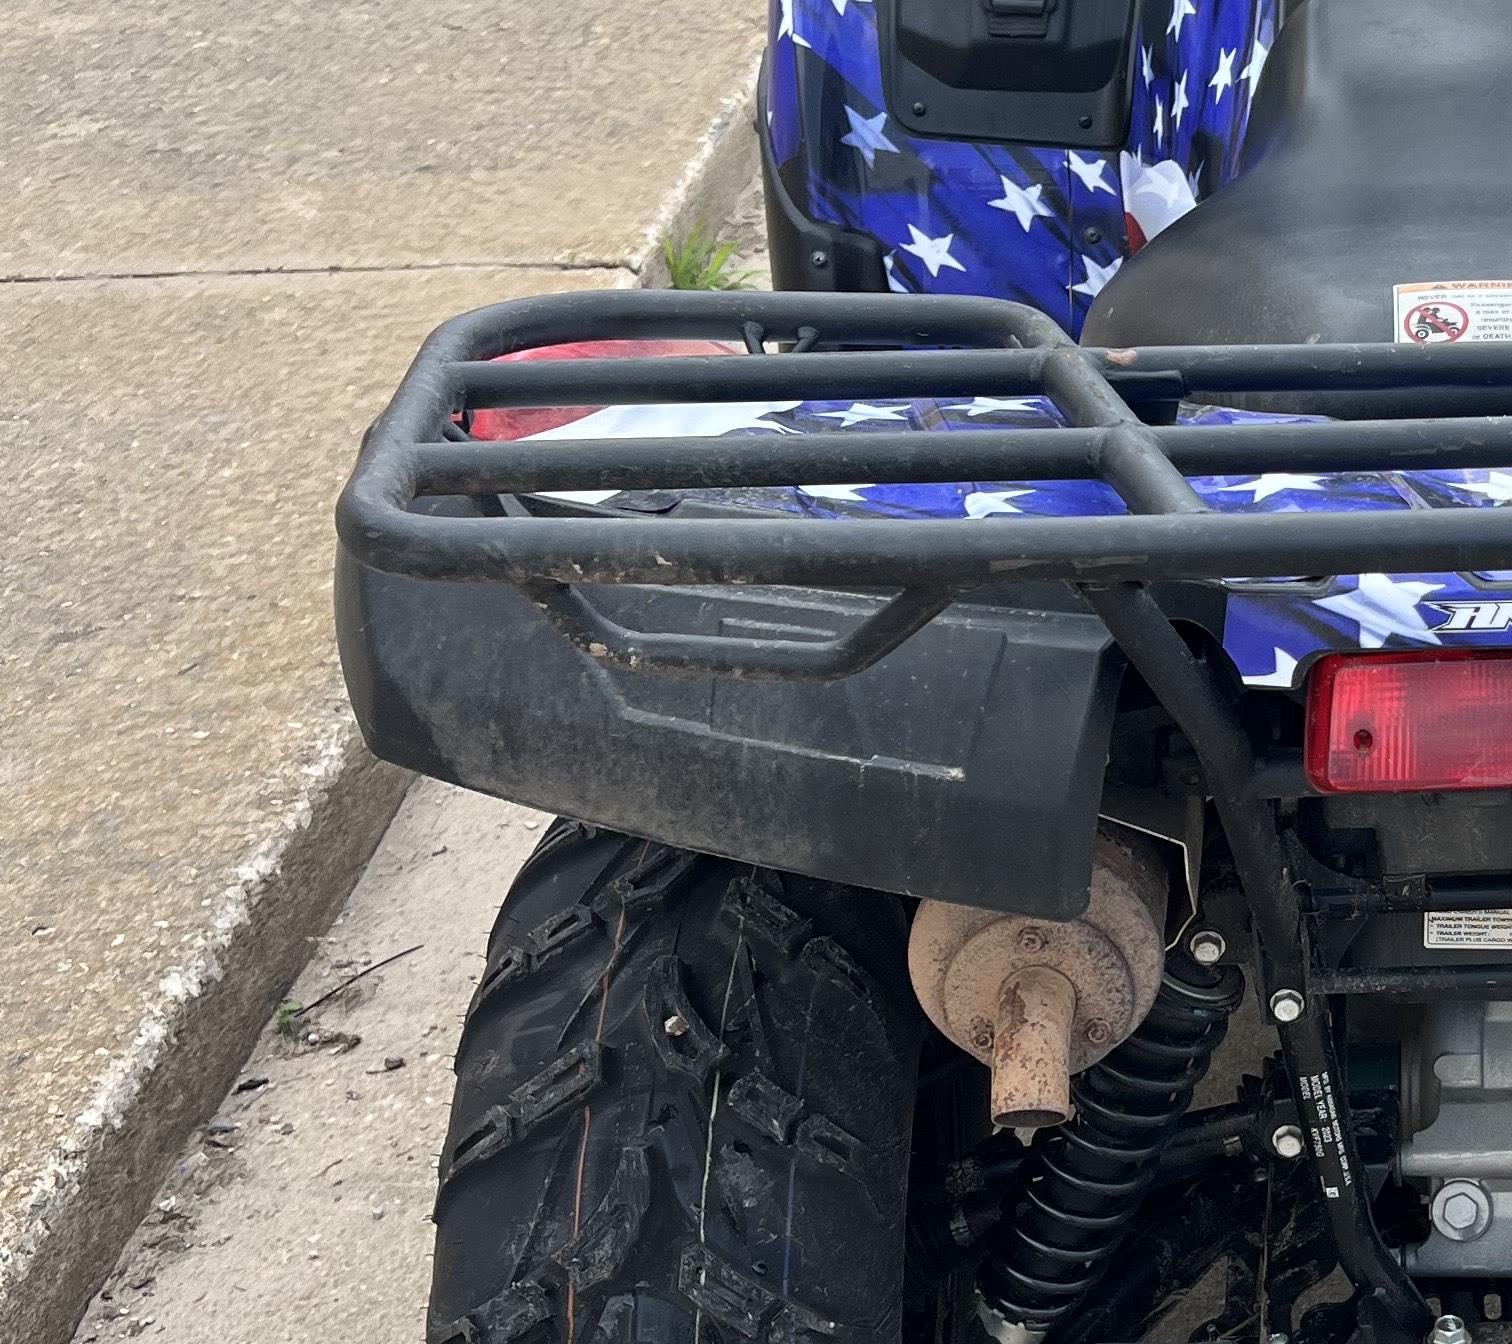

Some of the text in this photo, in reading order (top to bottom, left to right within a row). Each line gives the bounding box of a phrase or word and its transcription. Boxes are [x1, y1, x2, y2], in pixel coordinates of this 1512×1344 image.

[1299, 1076, 1311, 1100] MODEL
[1310, 1074, 1322, 1099] MODEL
[1321, 1126, 1332, 1143] 2023
